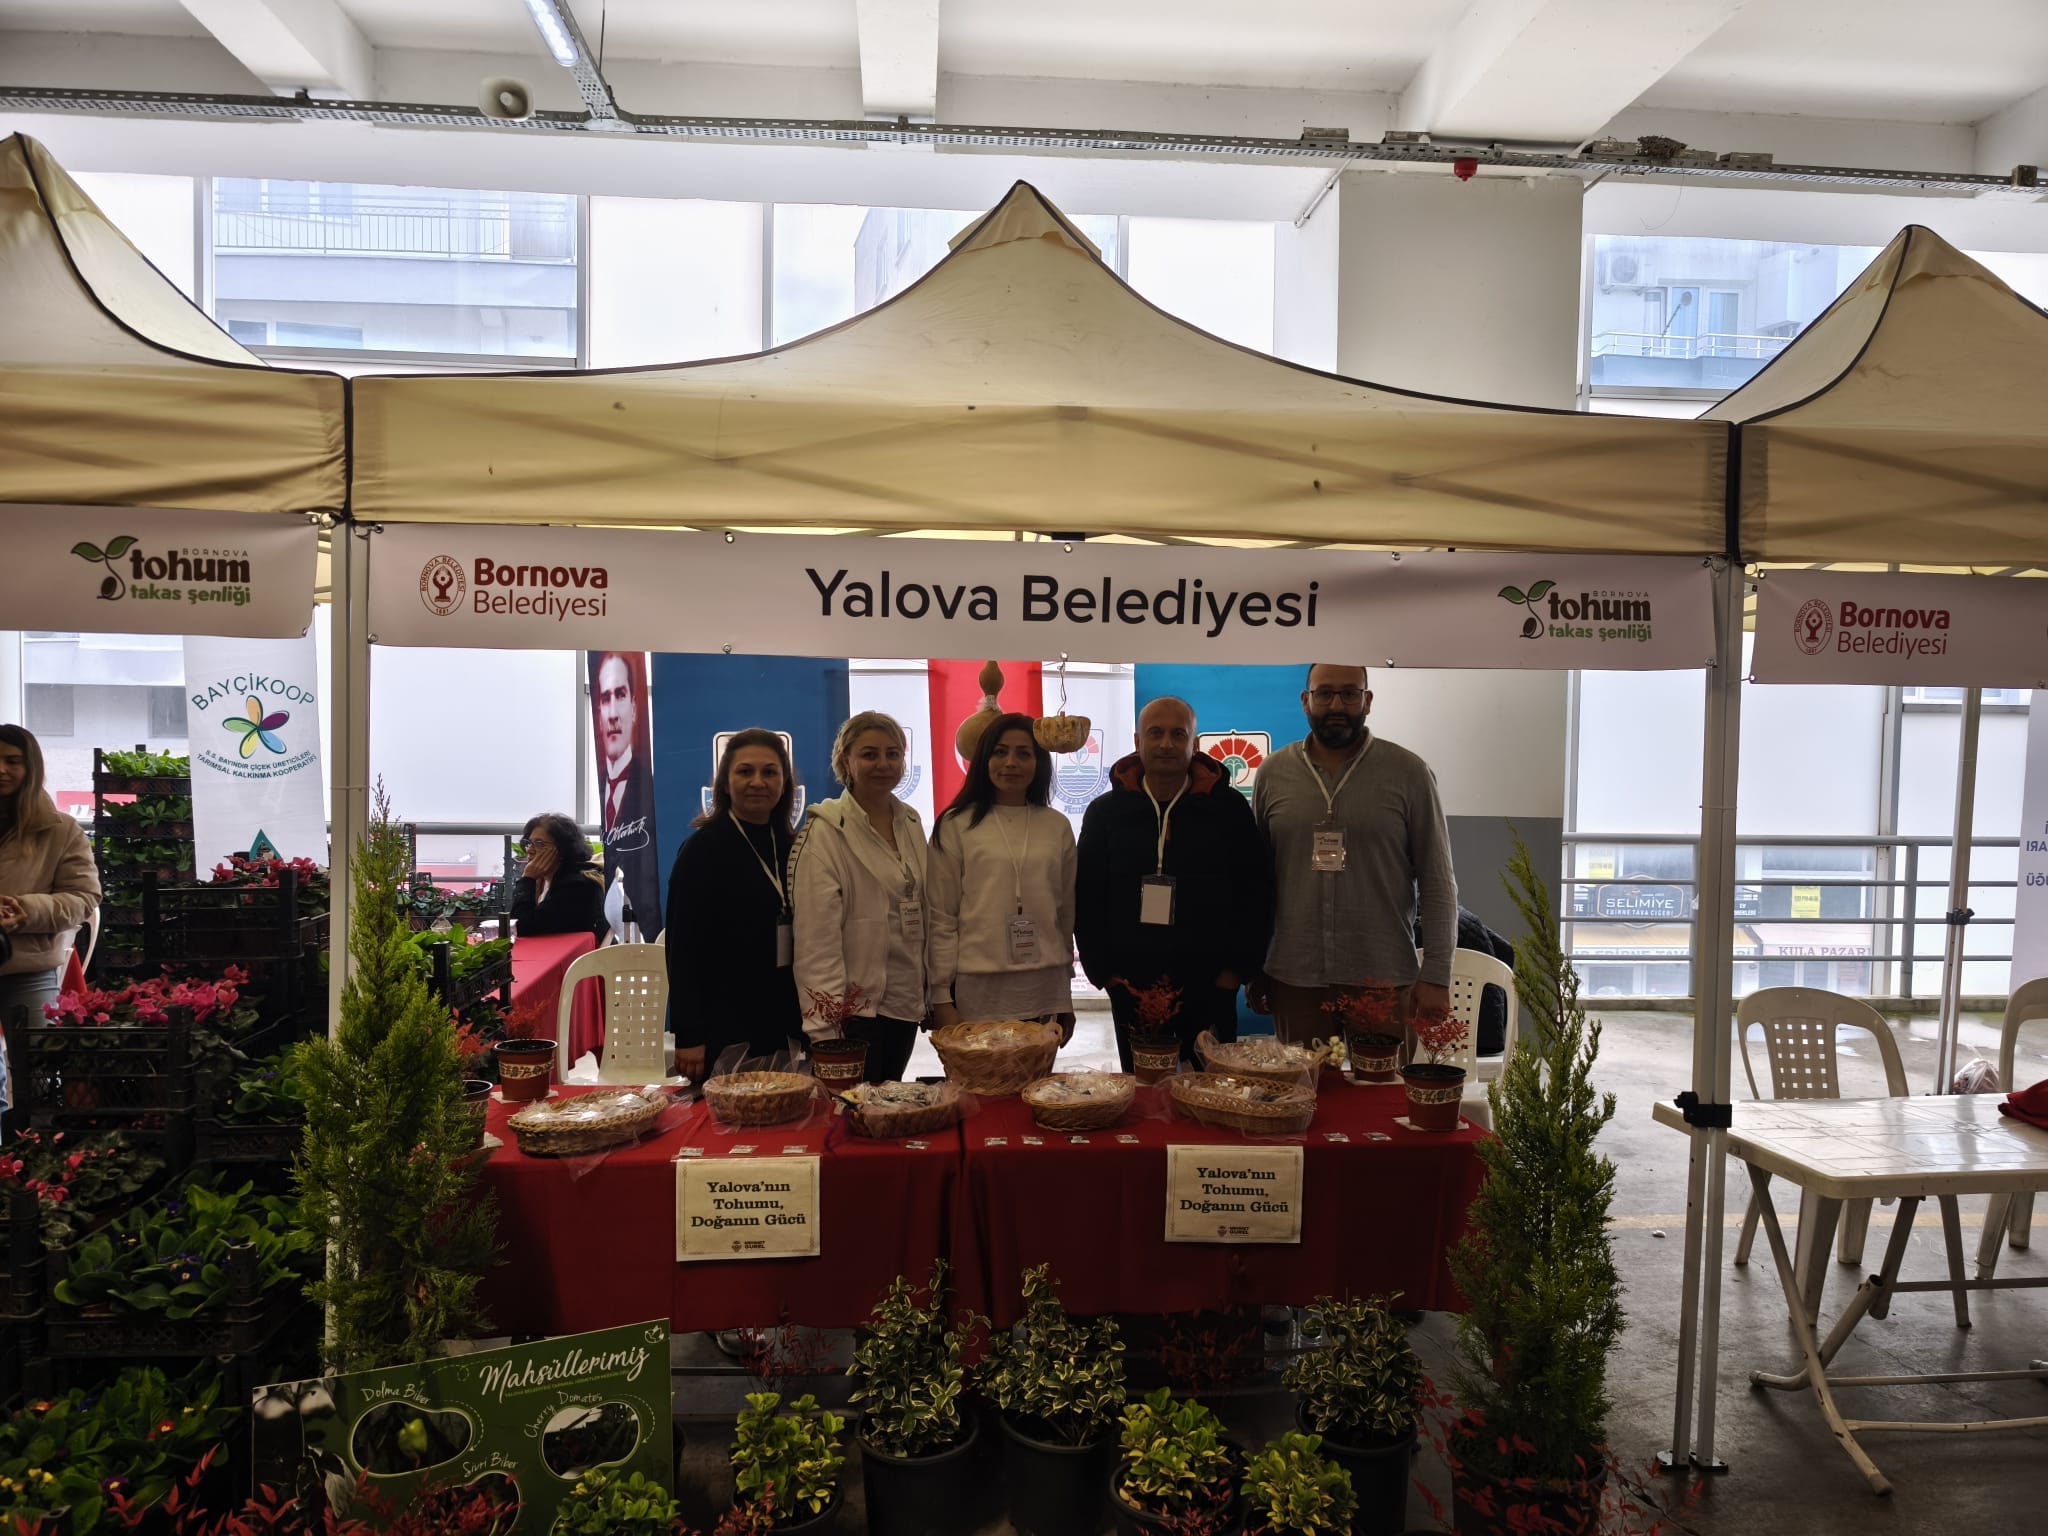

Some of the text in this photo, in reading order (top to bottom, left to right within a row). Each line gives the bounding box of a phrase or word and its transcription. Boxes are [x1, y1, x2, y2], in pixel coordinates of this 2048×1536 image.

[183, 548, 248, 557] BORNOVA
[129, 549, 251, 583] tohum
[474, 557, 608, 589] Bornova
[130, 584, 251, 606] takas şenliği
[474, 589, 606, 622] Belediyesi
[805, 568, 1319, 638] Yalova Belediyesi
[1593, 590, 1649, 598] BORNOVA
[1548, 592, 1651, 621] tohum
[1839, 601, 1950, 629] Bornova
[1548, 623, 1652, 642] takas şenliği
[1837, 630, 1948, 660] Belediyesi
[191, 672, 315, 711] BAYÇİKOOP
[196, 753, 231, 775] TARIMSAL
[232, 770, 272, 779] KALKINMA
[218, 756, 249, 769] BAYINDIR
[1606, 896, 1674, 909] SELİMİYE
[1778, 946, 1815, 956] KULA
[1202, 1184, 1269, 1197] Tohumu,
[713, 1199, 784, 1210] Tohumu,
[1180, 1200, 1289, 1213] Doğanın Gücü
[691, 1213, 806, 1229] Doğanın Gücü
[479, 1346, 650, 1403] Mahsüllerimiz
[360, 1381, 432, 1405] Dolma Biber
[523, 1390, 603, 1439] Cherry Domates
[489, 1451, 519, 1471] Biber
